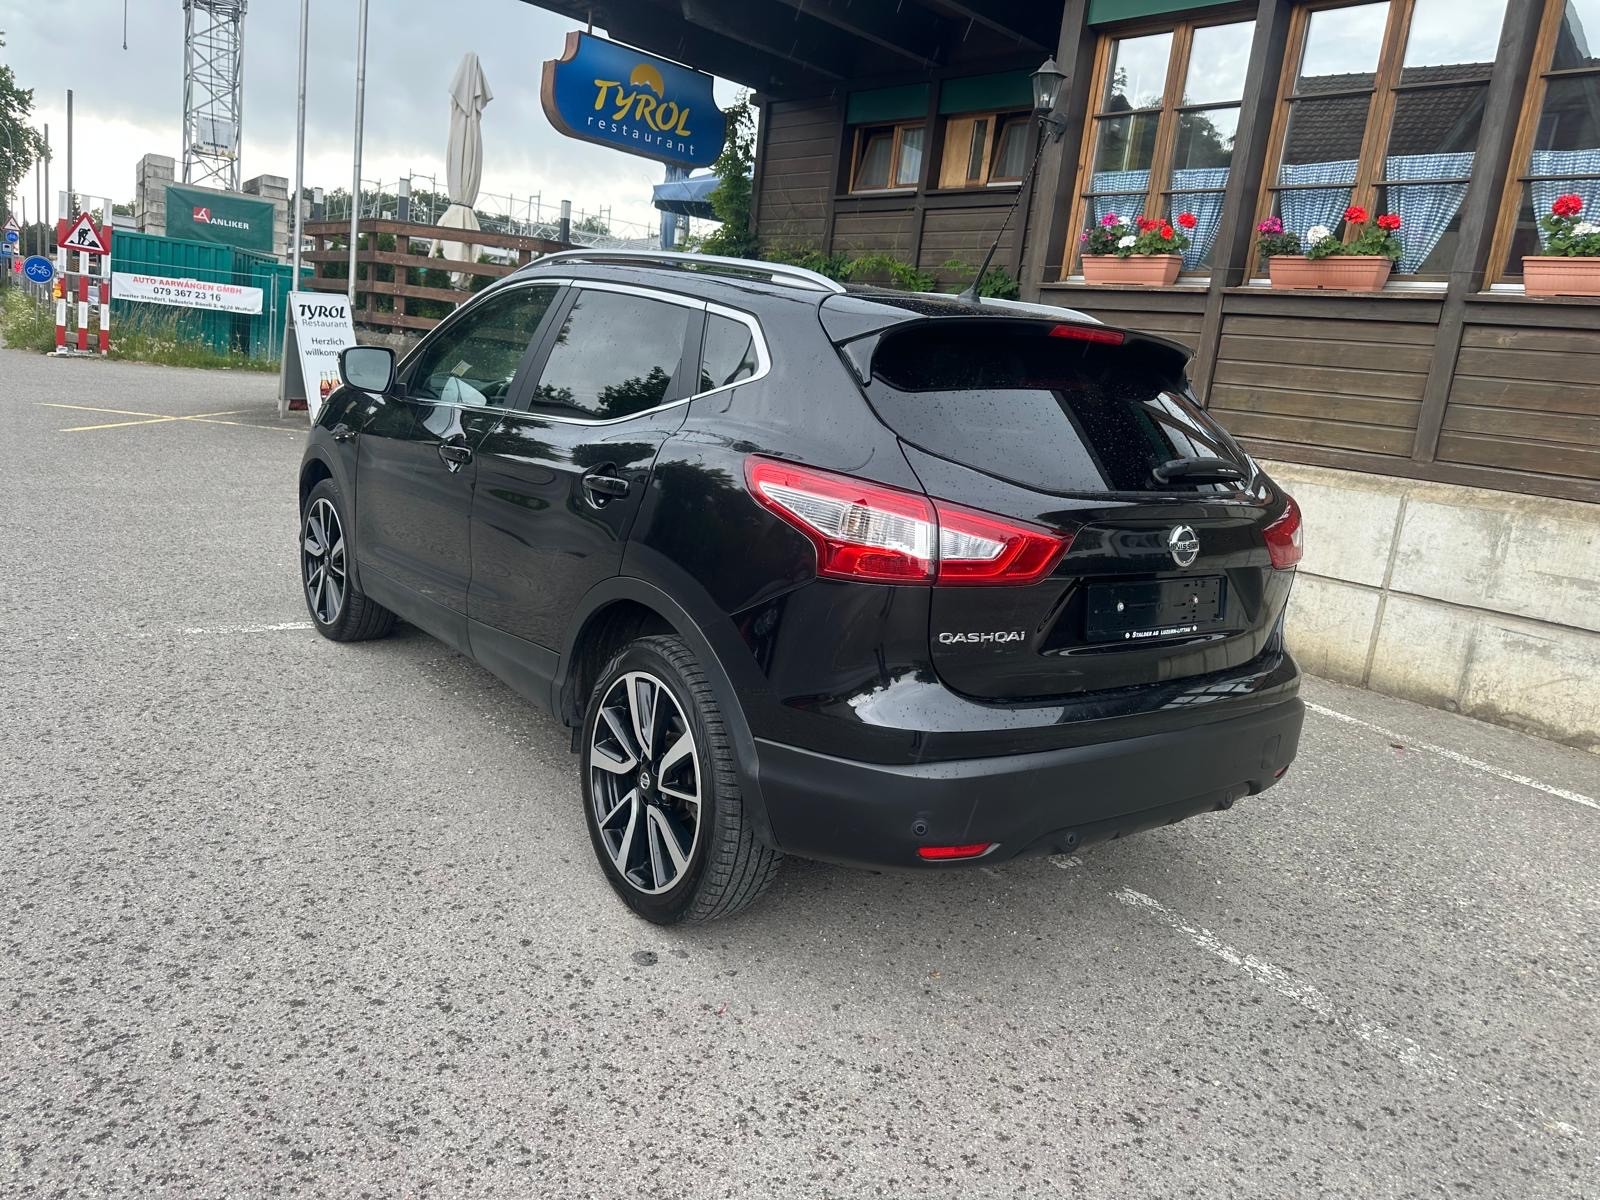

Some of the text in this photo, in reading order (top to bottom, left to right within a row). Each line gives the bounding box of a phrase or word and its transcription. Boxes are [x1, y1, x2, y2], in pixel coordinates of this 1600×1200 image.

[593, 78, 691, 137] TYROL
[587, 115, 695, 156] restaurant
[210, 218, 249, 230] ANLIKER
[133, 276, 157, 285] AUTO
[217, 284, 242, 294] GMBH
[153, 286, 221, 302] 079 367 23 16
[299, 304, 346, 320] TYROL
[302, 319, 348, 328] Restaurant
[311, 337, 345, 346] Herzlich
[938, 630, 1026, 645] QASHQAI
